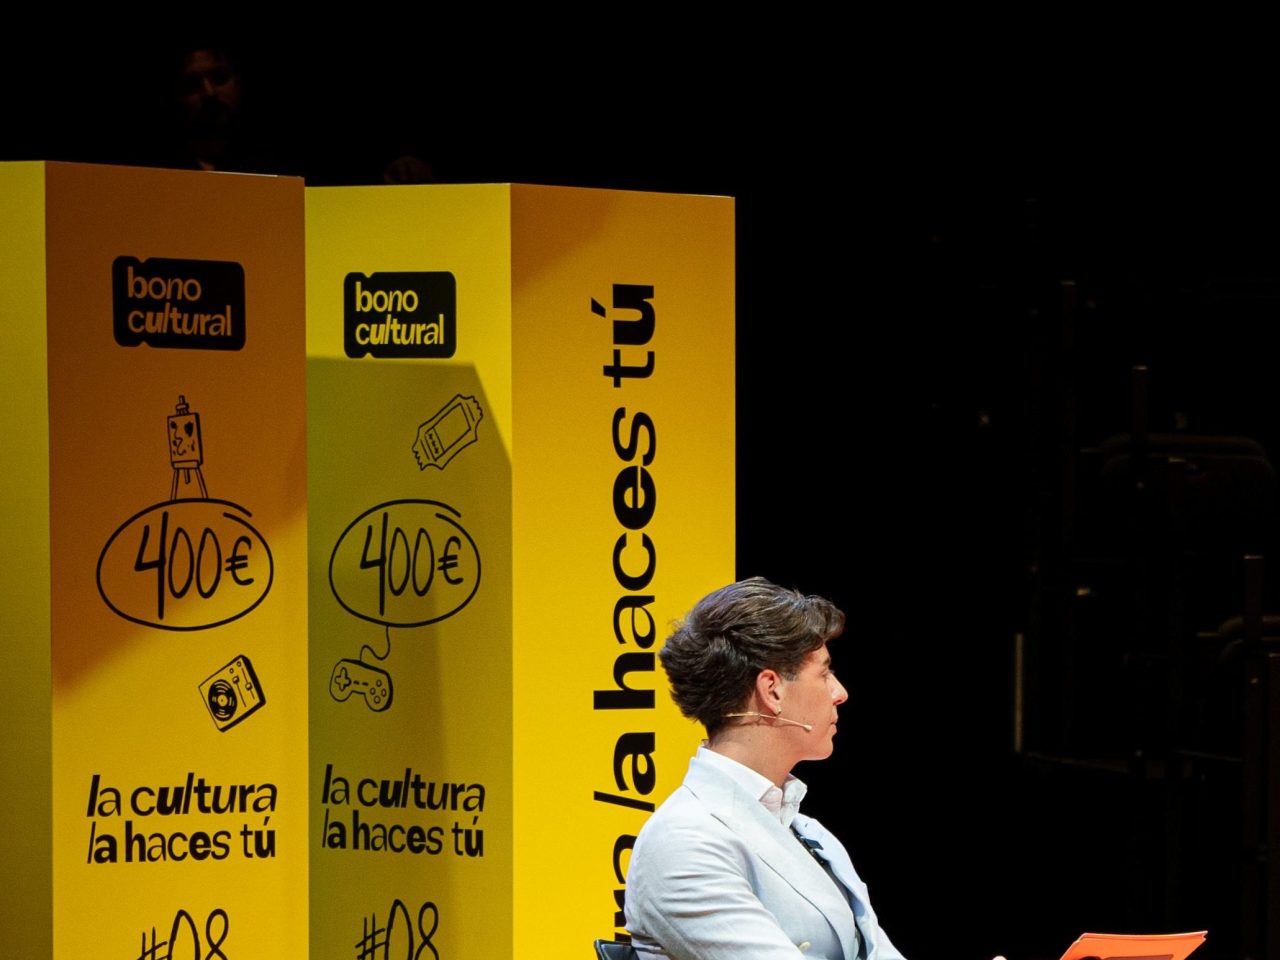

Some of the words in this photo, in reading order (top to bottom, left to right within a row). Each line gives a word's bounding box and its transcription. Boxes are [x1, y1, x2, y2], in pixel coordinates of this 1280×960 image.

[127, 266, 201, 300] bono
[355, 281, 418, 312] bono
[127, 302, 232, 337] cultural
[355, 314, 444, 345] cultural
[590, 282, 657, 390] tú
[134, 511, 255, 620] 400€
[359, 511, 465, 616] 400€
[593, 406, 658, 711] haces
[86, 774, 122, 817] la
[130, 772, 278, 816] cultura
[320, 763, 350, 806] la
[357, 768, 486, 813] cultura
[593, 731, 657, 814] la
[86, 821, 118, 864] la
[124, 820, 231, 862] haces
[240, 814, 276, 859] tú
[321, 808, 347, 850] la
[352, 809, 443, 856] haces
[452, 815, 485, 858] tú
